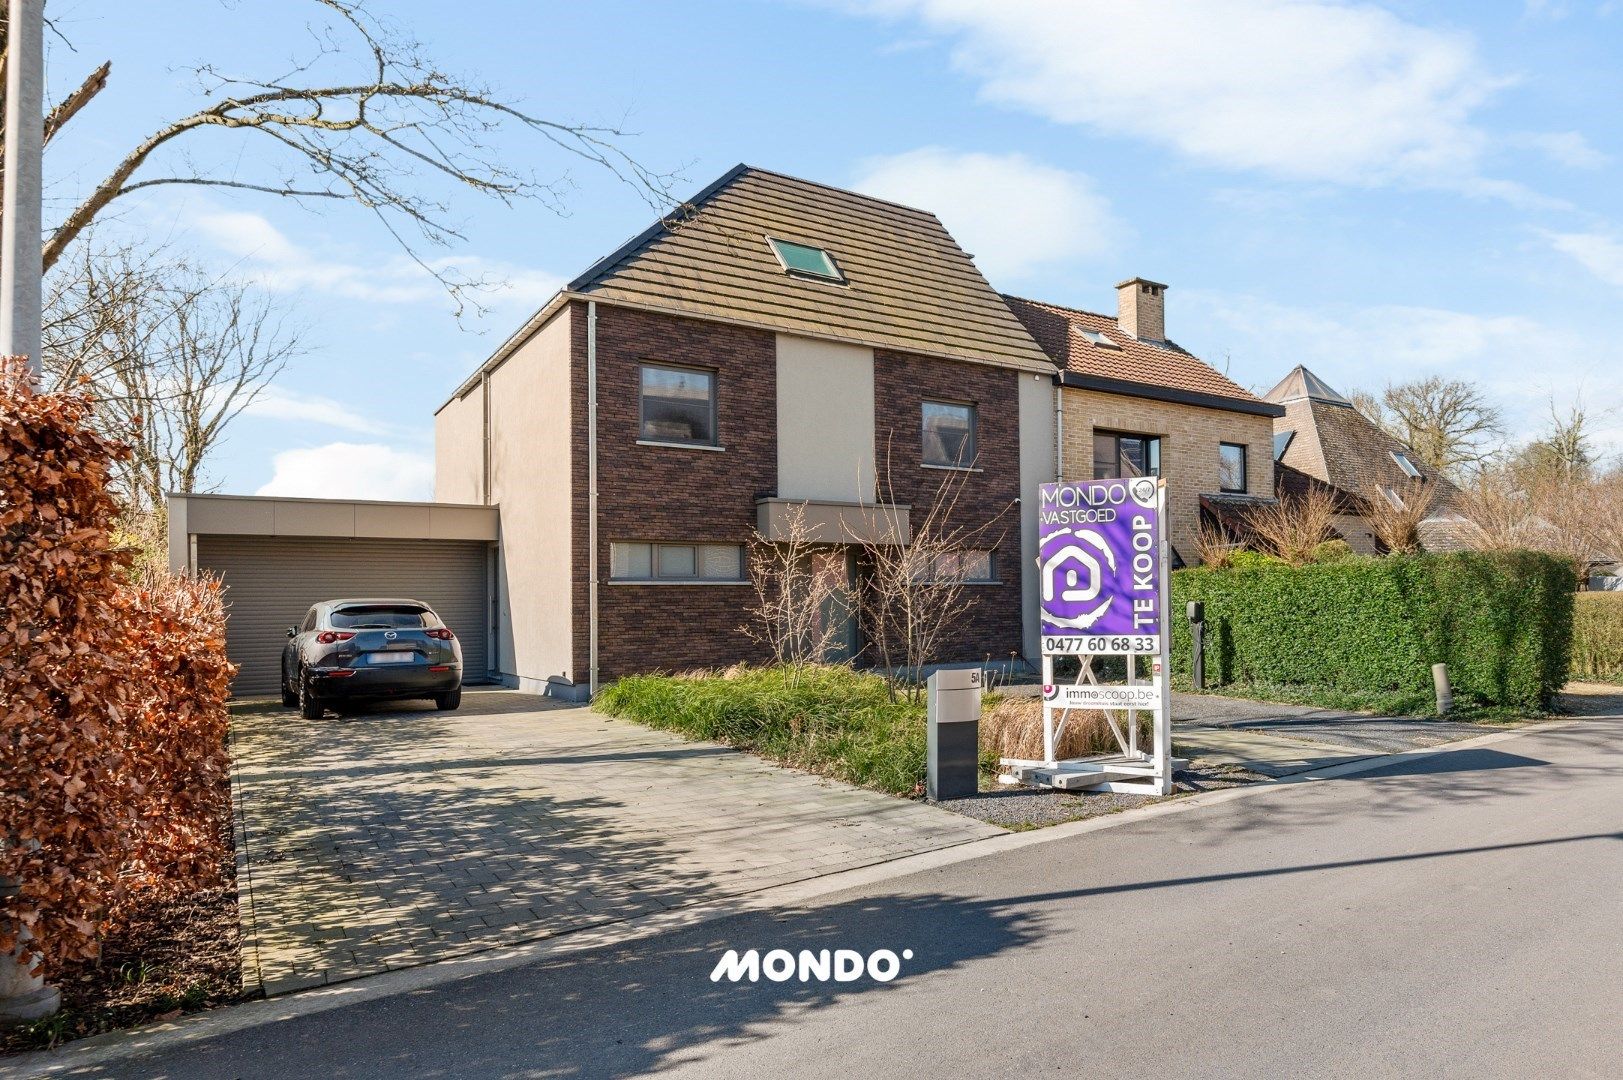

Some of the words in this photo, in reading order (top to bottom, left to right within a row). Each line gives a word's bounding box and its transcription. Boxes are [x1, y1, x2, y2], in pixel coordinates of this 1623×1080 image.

[1042, 484, 1126, 508] MONDO
[1042, 509, 1116, 524] VASTGOED
[1132, 515, 1153, 590] KOOP
[1133, 599, 1154, 630] TE
[1046, 638, 1083, 651] 0477
[1088, 638, 1106, 651] 60
[1111, 638, 1130, 651] 68
[1134, 637, 1154, 651] 33
[1066, 687, 1153, 701] immoscoop.be
